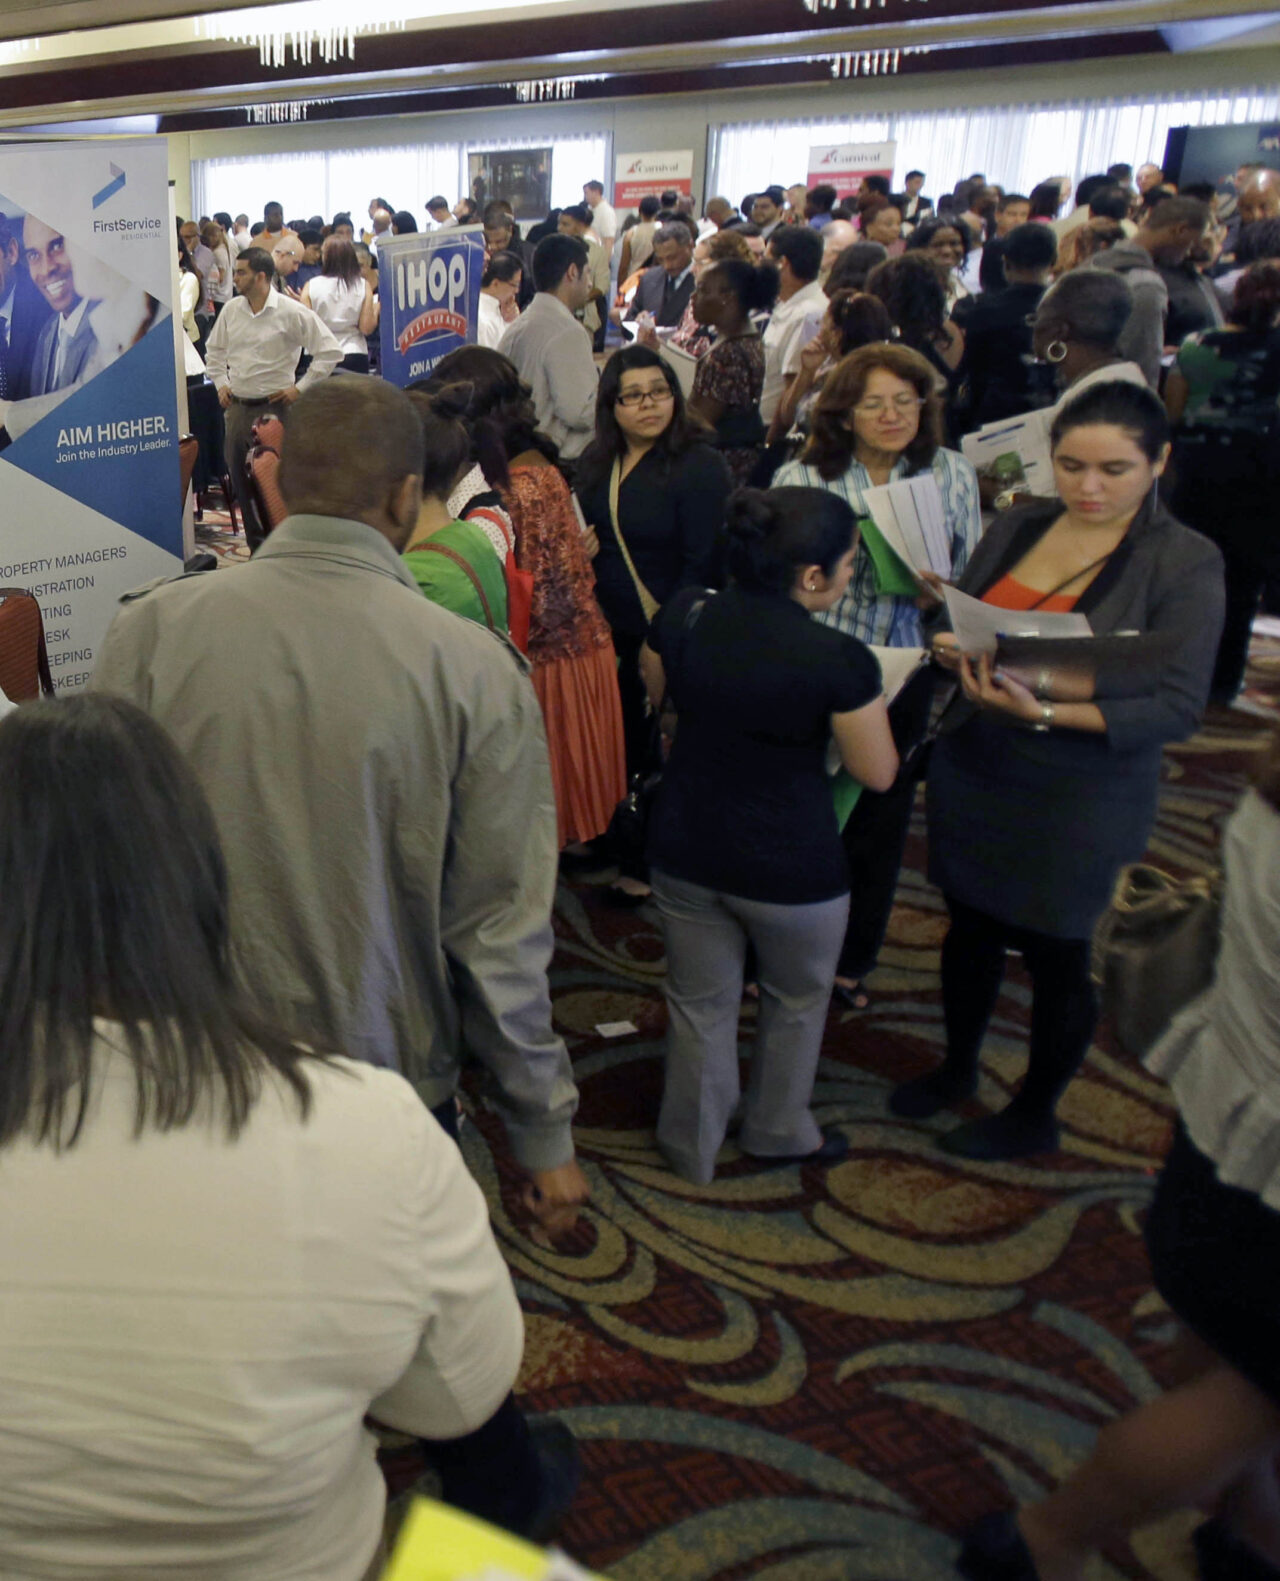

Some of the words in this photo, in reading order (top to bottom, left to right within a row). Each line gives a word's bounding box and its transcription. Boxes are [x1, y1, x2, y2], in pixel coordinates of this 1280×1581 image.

[93, 217, 161, 233] FirstService
[121, 232, 161, 241] RESIDENTIAL
[397, 254, 466, 314] IHOP
[404, 314, 462, 344] RESTAURANT
[409, 360, 425, 377] JOIN
[426, 358, 431, 372] A
[56, 425, 93, 448] AIM
[97, 416, 170, 443] HIGHER.
[56, 449, 77, 464] Join
[79, 446, 96, 460] the
[98, 441, 138, 459] Industry
[140, 438, 171, 453] Leader.
[55, 546, 127, 569] MANAGERS
[46, 628, 71, 644] ESK
[47, 648, 92, 667] EEPING
[51, 672, 90, 690] SKEEP
